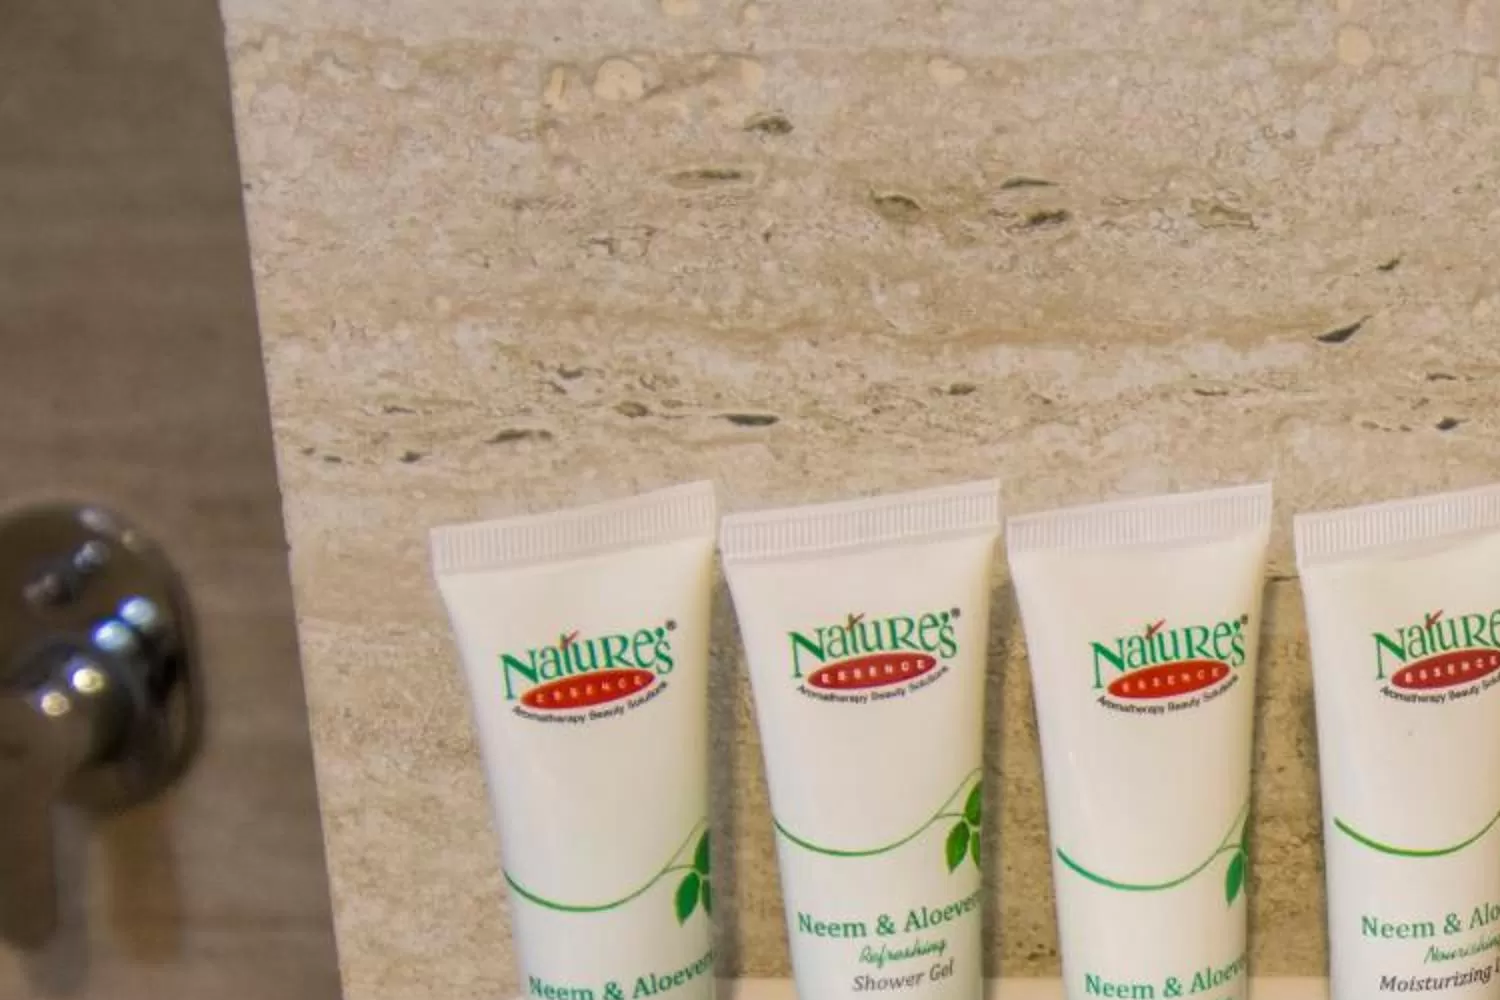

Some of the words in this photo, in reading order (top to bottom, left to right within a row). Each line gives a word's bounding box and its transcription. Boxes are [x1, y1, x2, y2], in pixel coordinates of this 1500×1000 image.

[798, 912, 867, 938] Neem
[875, 913, 896, 935] &
[1361, 916, 1435, 938] Neem
[1443, 912, 1461, 935] &
[852, 972, 924, 992] Shower
[929, 957, 954, 981] Gel
[1084, 972, 1155, 999] Neem
[1163, 976, 1183, 998] &
[1380, 965, 1492, 993] Moisturizing
[602, 981, 625, 1000] &
